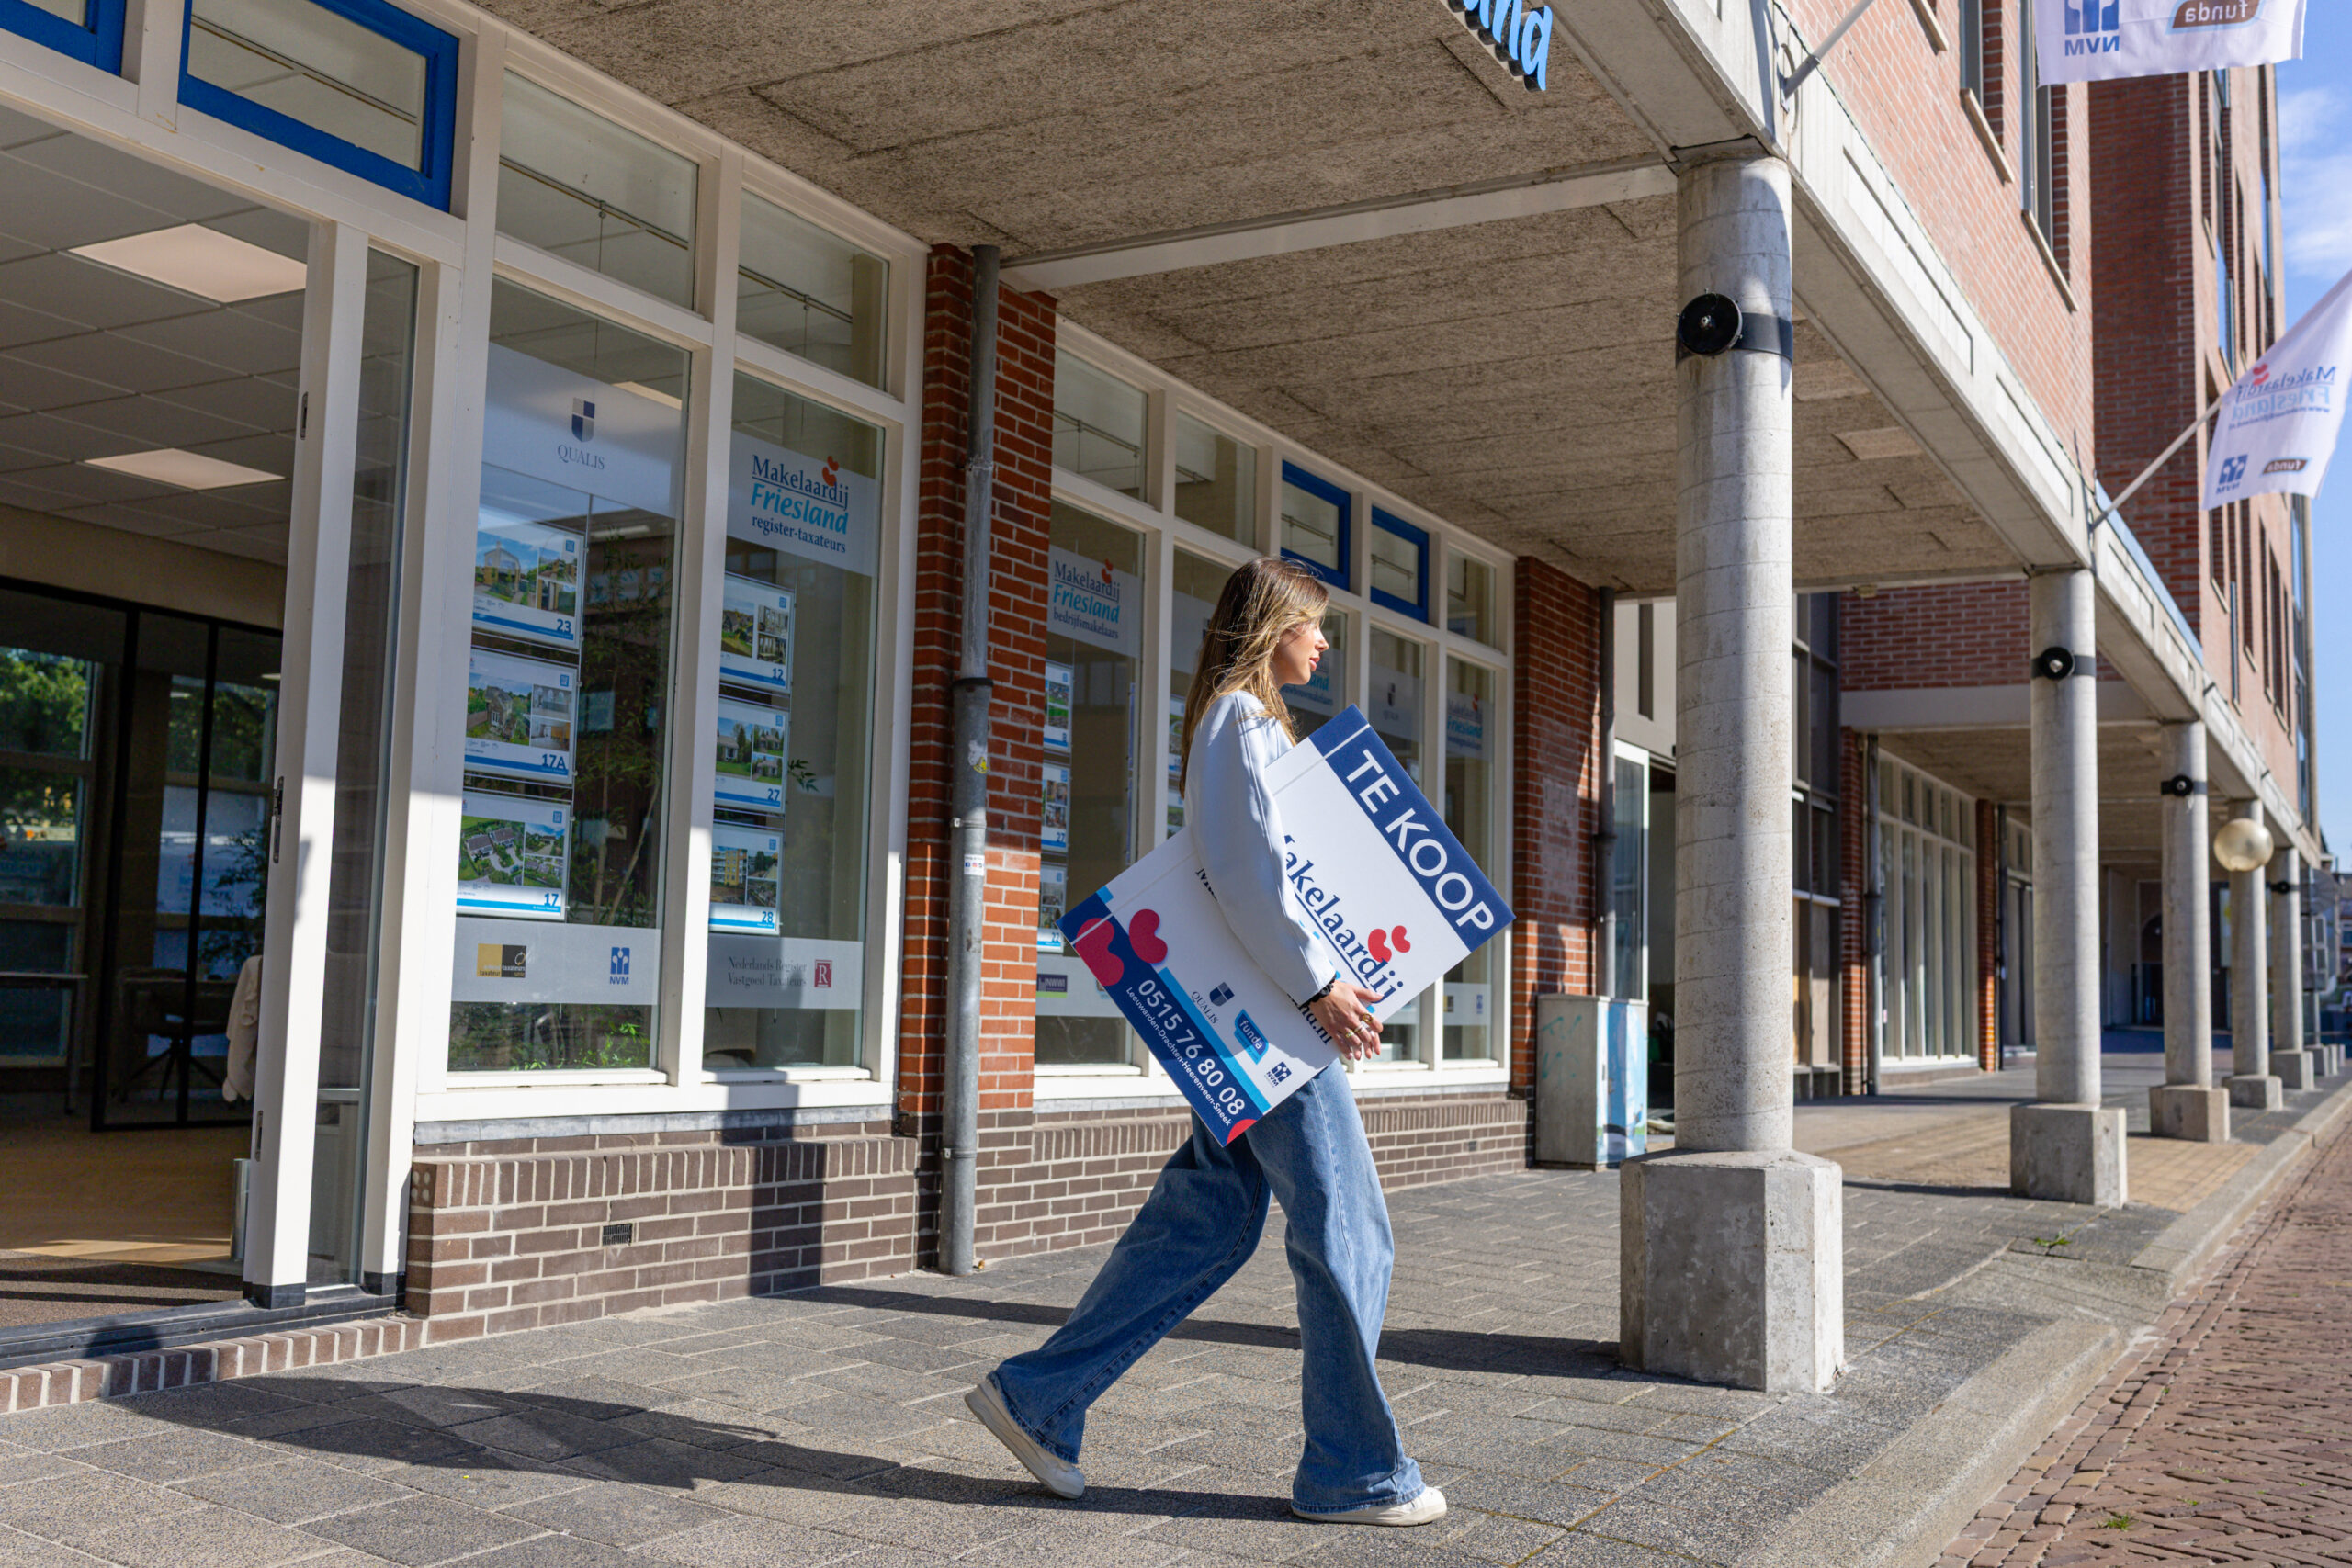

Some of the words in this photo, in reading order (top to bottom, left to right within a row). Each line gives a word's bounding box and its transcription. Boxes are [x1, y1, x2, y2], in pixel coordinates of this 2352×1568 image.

[557, 444, 605, 470] QUALIS
[752, 454, 849, 512] Makelaardij
[751, 482, 849, 536] Friesland
[752, 515, 846, 553] register-taxateurs
[1054, 559, 1121, 604] Makelaardij
[1053, 584, 1121, 625] Friesland
[556, 618, 571, 634] 23
[1053, 606, 1119, 640] bedrijfsmakelaars
[772, 668, 785, 681] 12
[542, 753, 567, 770] 17A
[767, 788, 780, 801] 27
[1346, 749, 1400, 814] TE
[1385, 808, 1495, 931] KOOP
[544, 892, 560, 907] 17
[762, 910, 774, 923] 28
[1284, 835, 1404, 1004] akelaardij
[728, 955, 774, 971] Nederlands
[775, 958, 808, 975] Register
[818, 964, 828, 985] R
[609, 976, 629, 986] NVM
[727, 972, 766, 991] Vastgoed
[767, 973, 807, 988] Taxateurs
[1191, 991, 1219, 1025] QUALIS
[1138, 978, 1183, 1032] 0515
[1176, 1028, 1204, 1059] 76
[1197, 1058, 1224, 1087] 80
[1218, 1087, 1246, 1116] 08
[1239, 1020, 1262, 1050] funda
[1266, 1071, 1279, 1087] NVM
